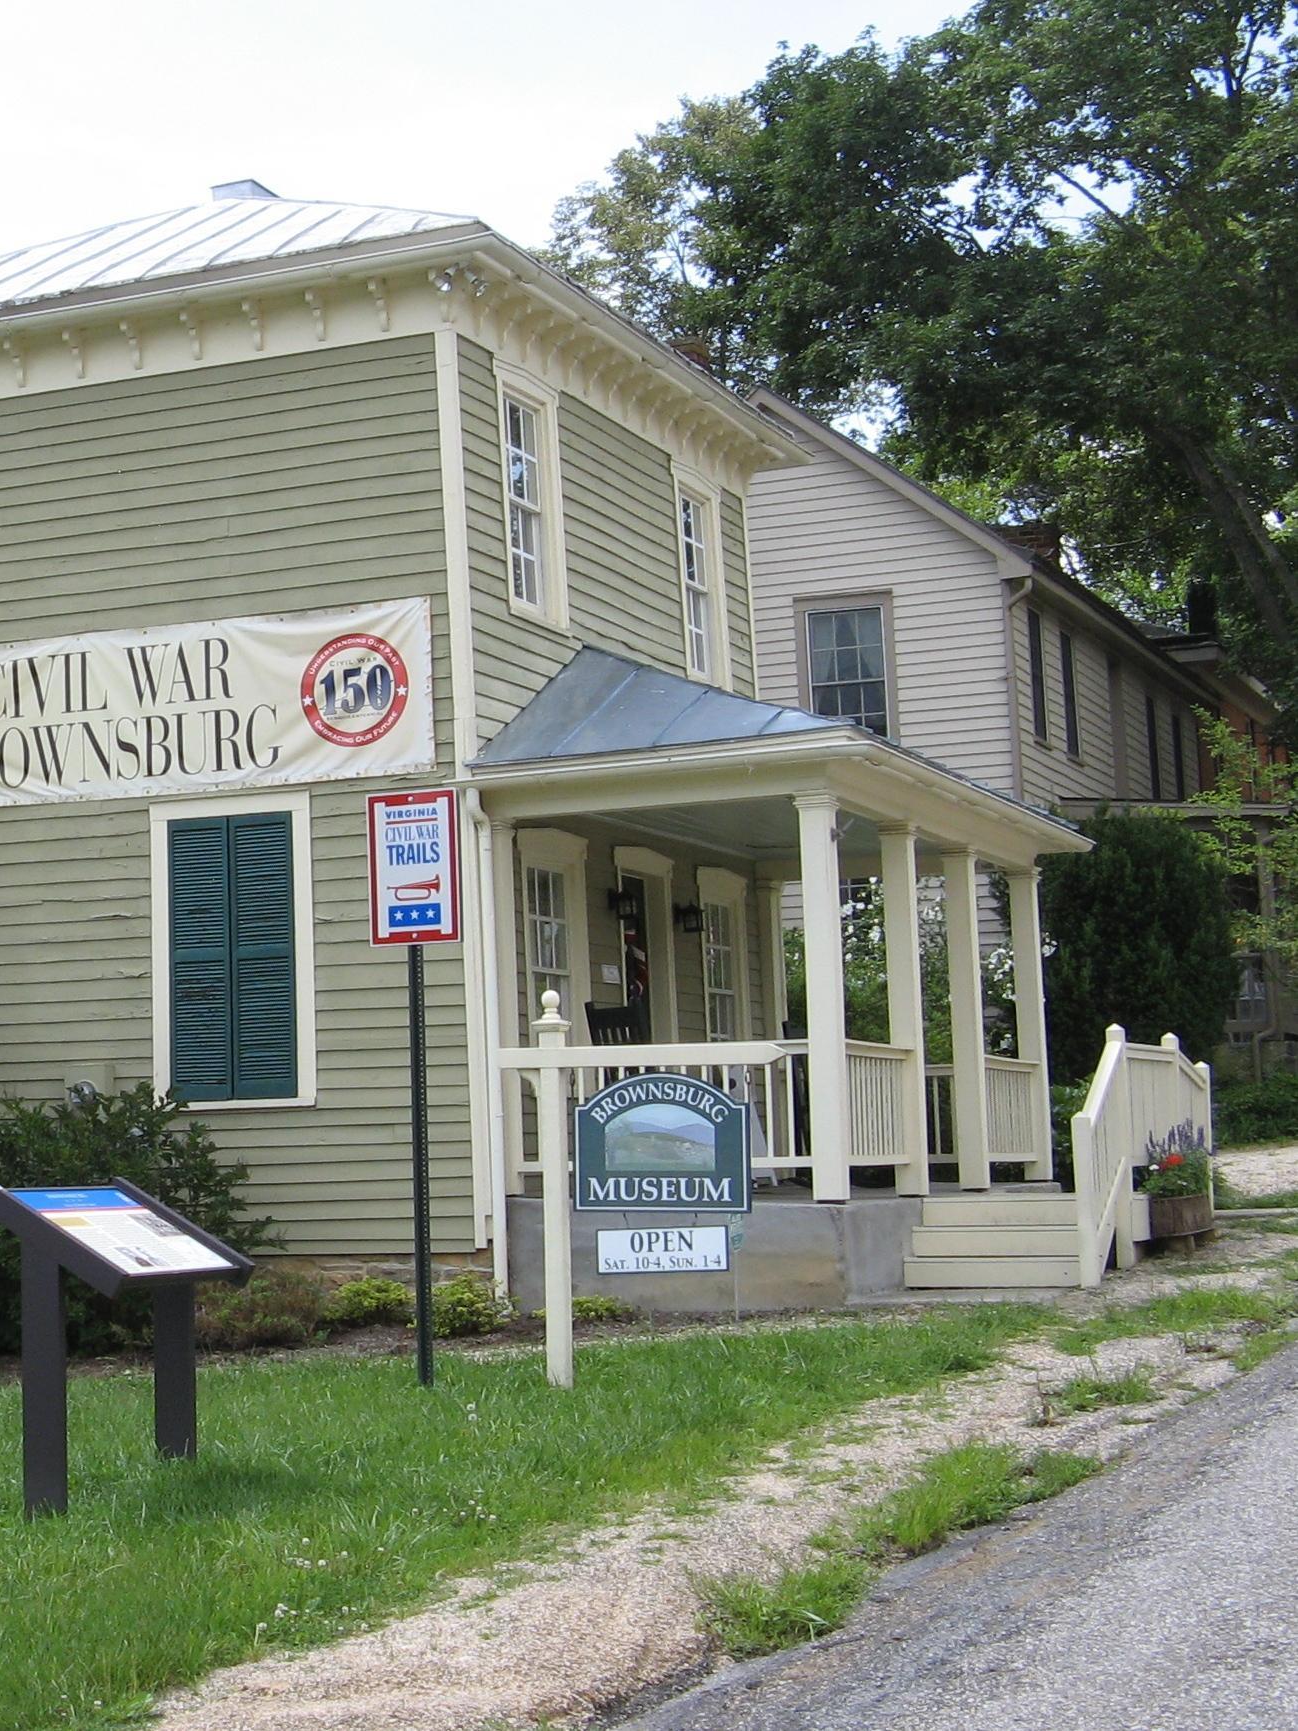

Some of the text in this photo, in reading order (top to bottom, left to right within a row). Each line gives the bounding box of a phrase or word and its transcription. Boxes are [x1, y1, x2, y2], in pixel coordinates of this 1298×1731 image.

[123, 638, 234, 708] WAR
[320, 664, 392, 716] 150
[385, 807, 437, 819] VIRGINIA
[385, 824, 439, 842] CIVIL WAR
[386, 841, 440, 866] TRAILS
[590, 1082, 729, 1125] BROWNSBURG
[588, 1177, 732, 1202] MUSEUM
[630, 1230, 694, 1254] OPEN
[635, 1256, 665, 1270] 10-4,
[703, 1255, 721, 1268] 1-4
